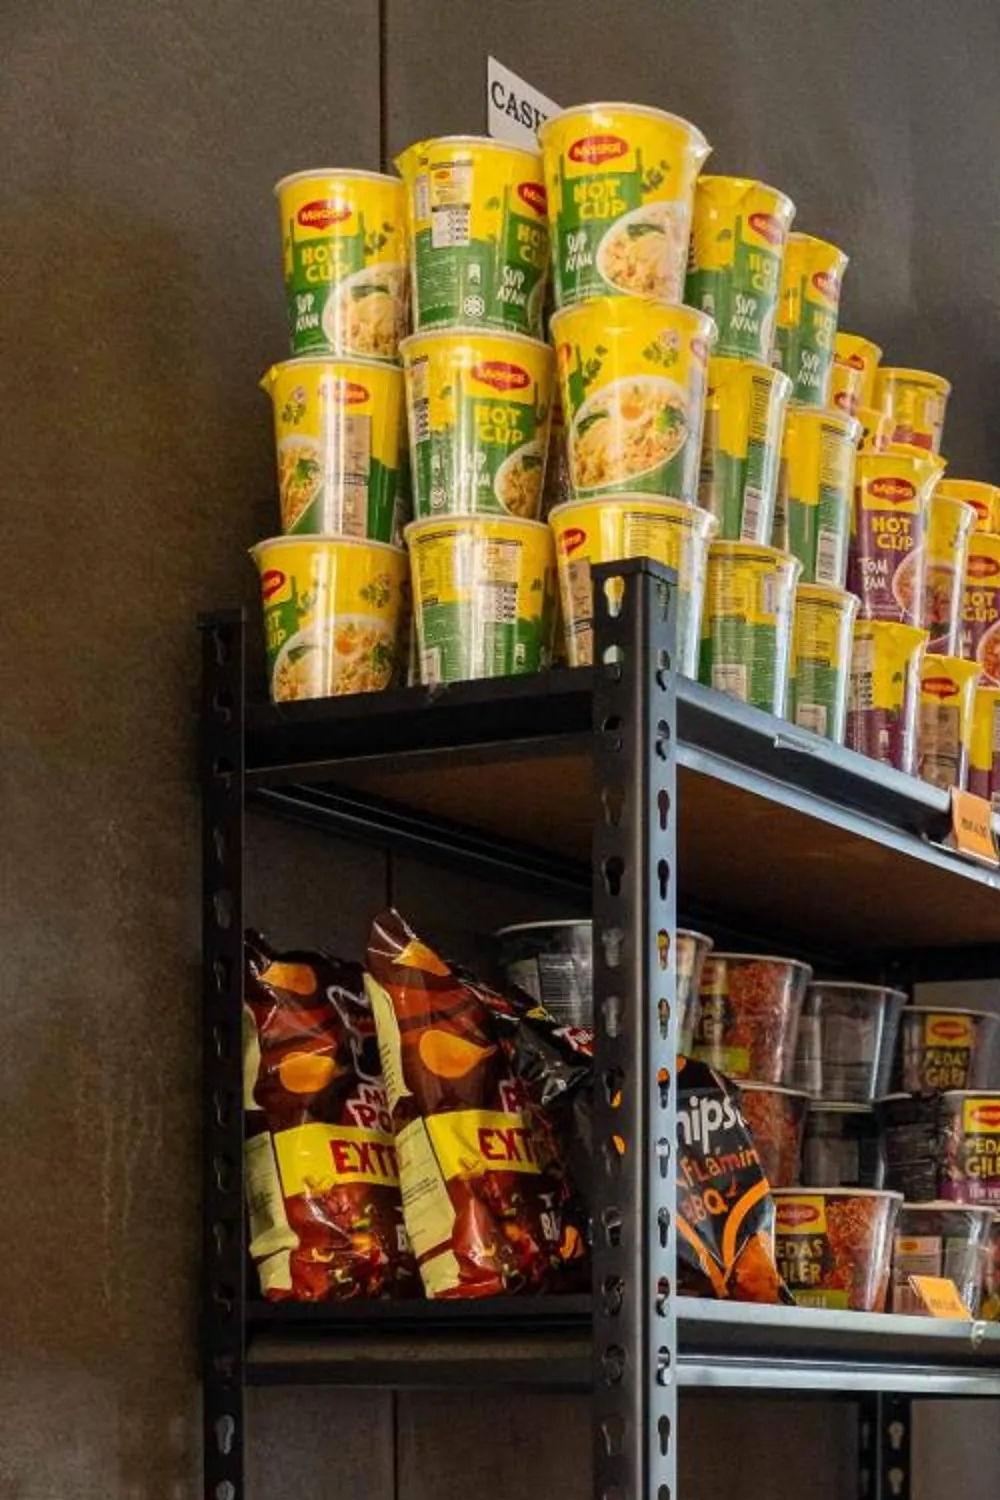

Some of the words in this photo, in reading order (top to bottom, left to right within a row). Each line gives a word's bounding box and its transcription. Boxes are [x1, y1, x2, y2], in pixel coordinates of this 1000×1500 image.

[574, 180, 621, 202] HOT
[579, 199, 627, 219] CUP
[480, 425, 523, 445] CUP
[871, 516, 912, 533] HOT
[876, 533, 914, 550] CUP
[776, 1239, 823, 1258] EDAS
